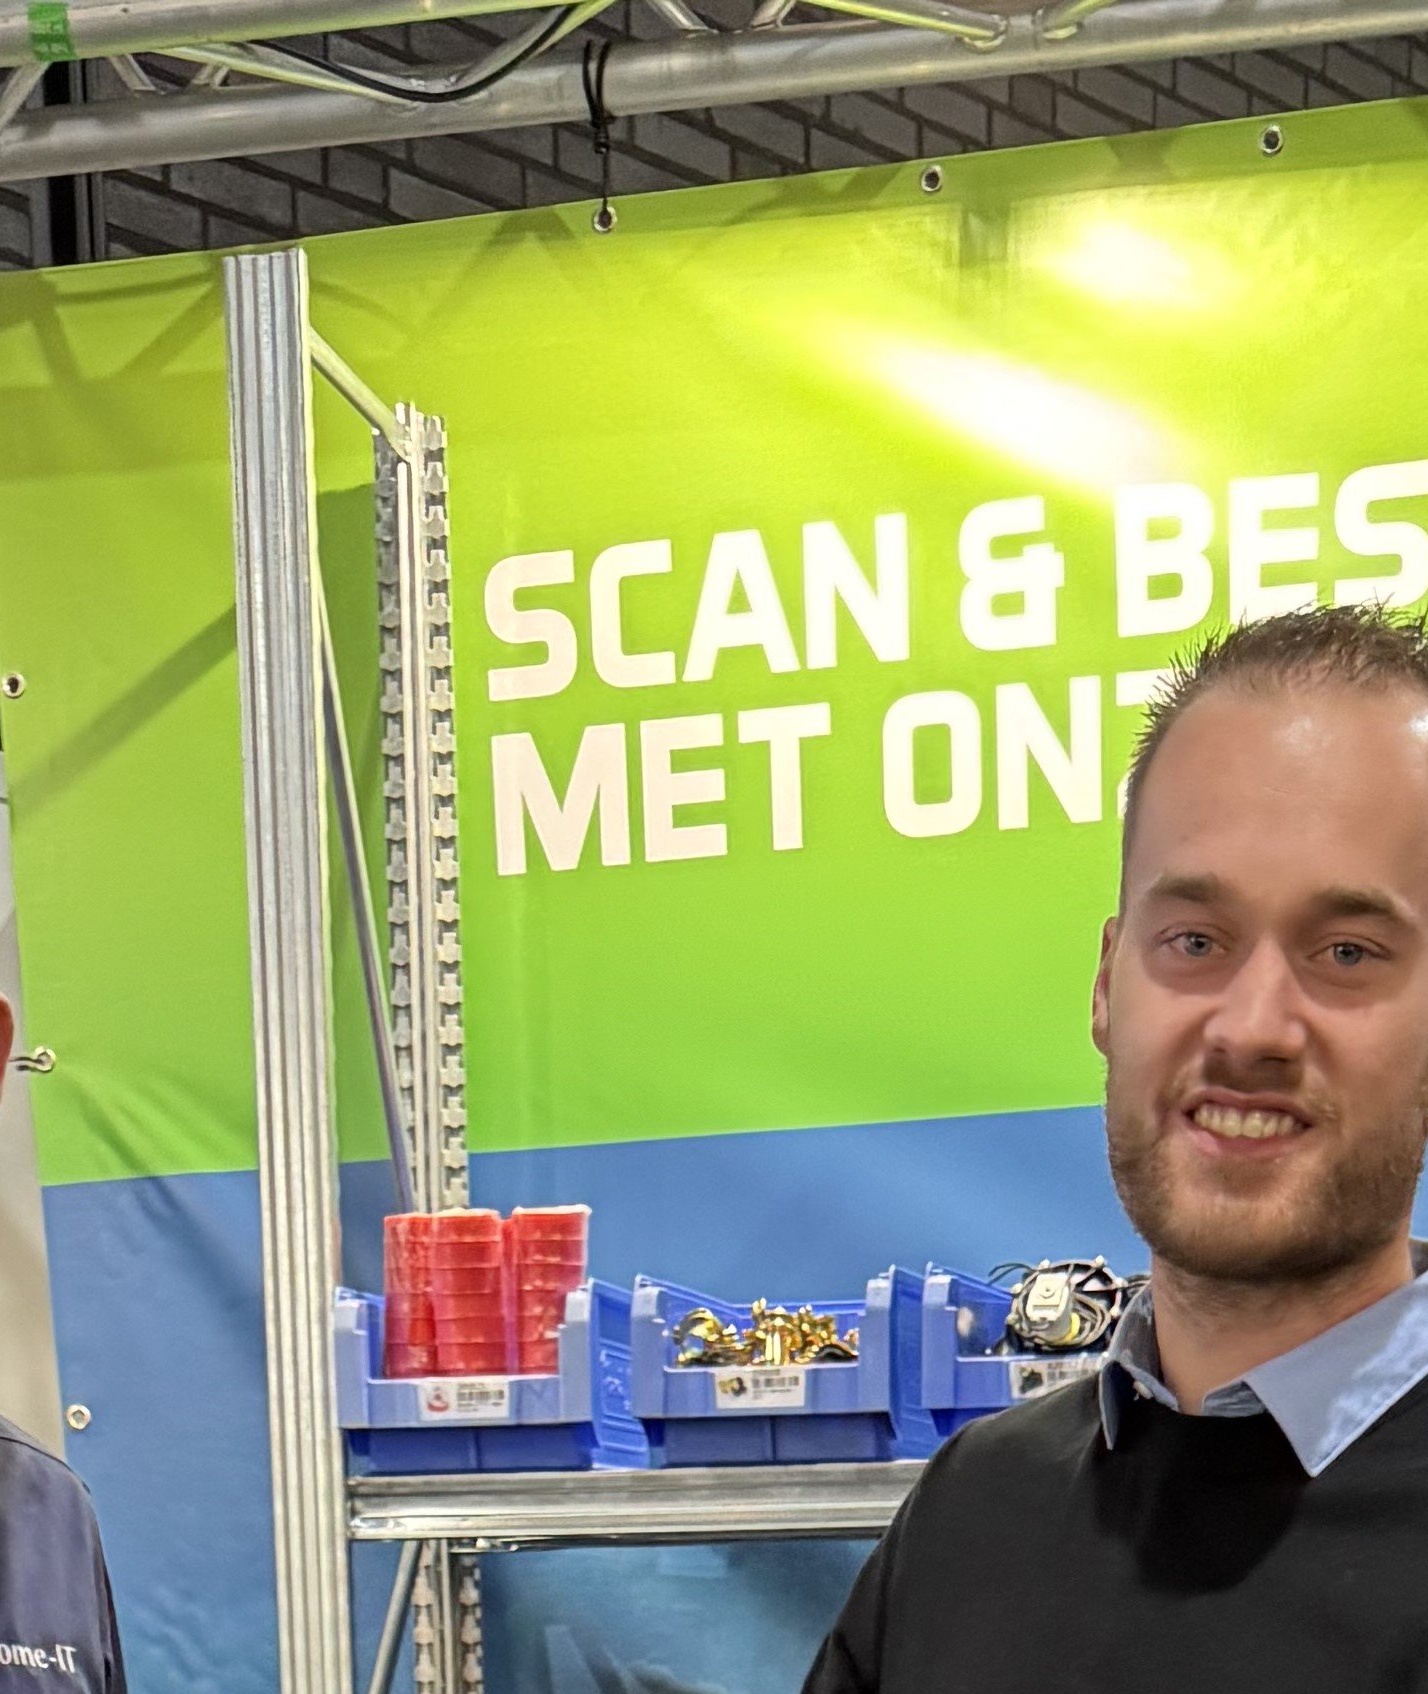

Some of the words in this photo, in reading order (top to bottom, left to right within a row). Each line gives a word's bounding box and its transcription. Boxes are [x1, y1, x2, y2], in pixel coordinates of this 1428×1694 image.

[484, 512, 910, 702] SCAN
[958, 495, 1065, 651] &
[491, 702, 831, 876] MET
